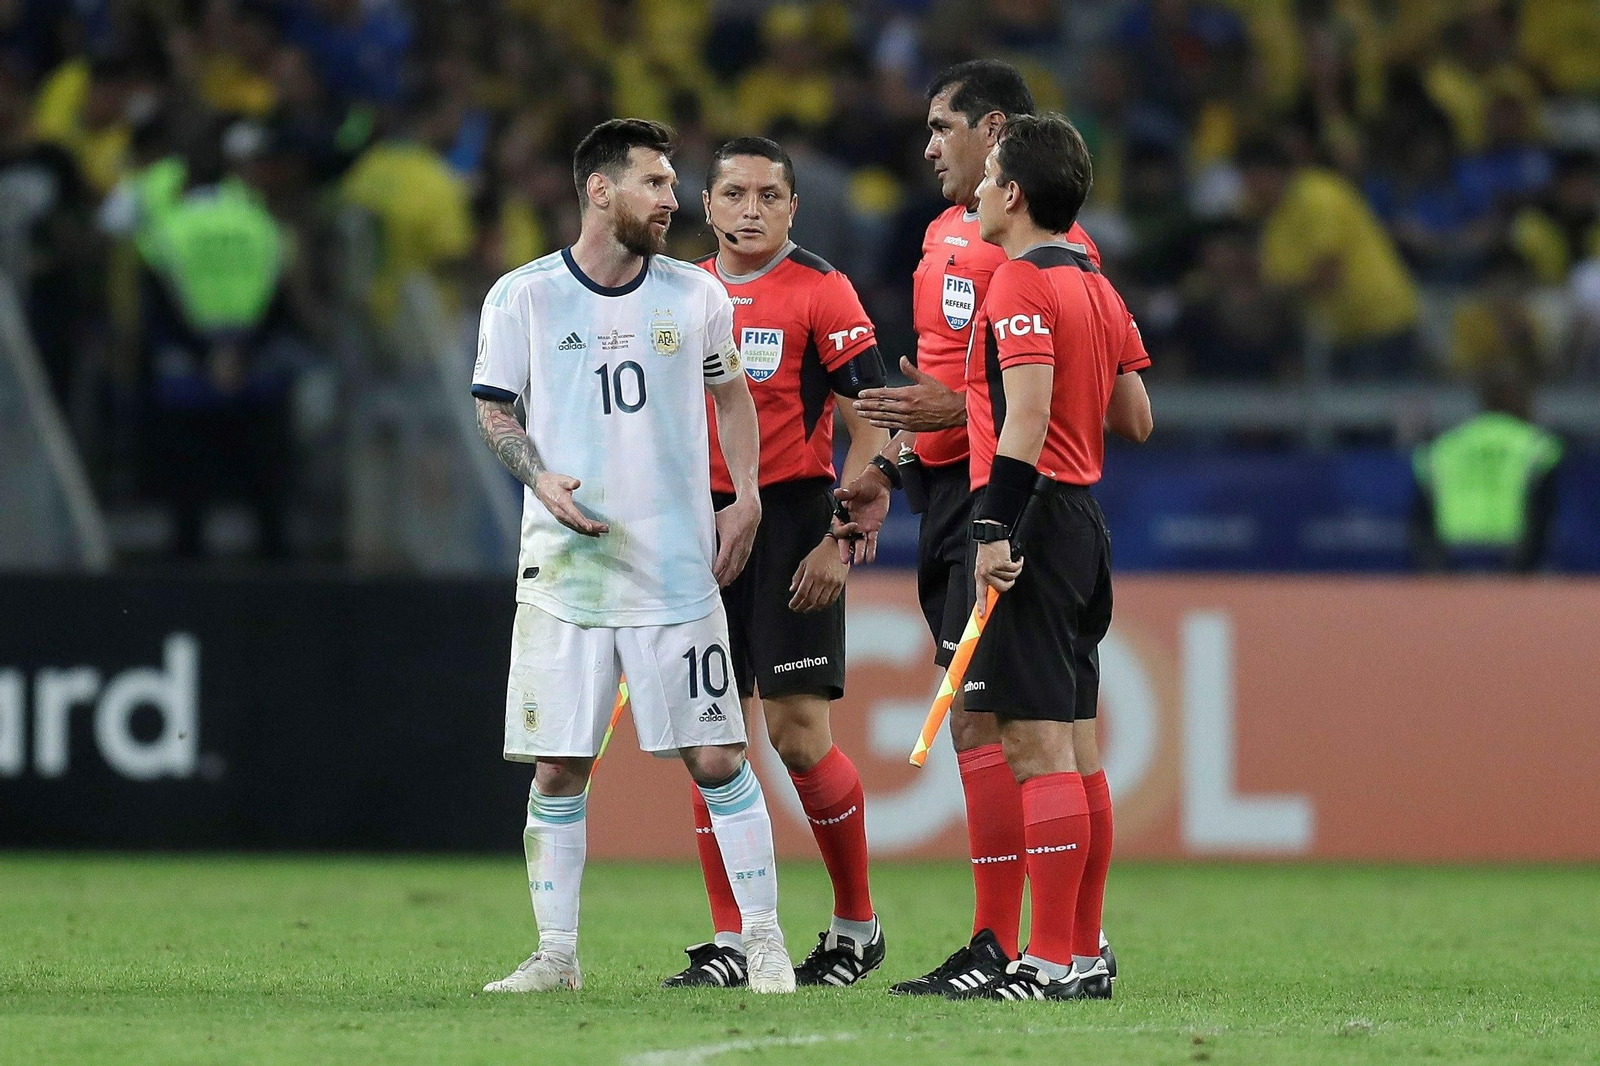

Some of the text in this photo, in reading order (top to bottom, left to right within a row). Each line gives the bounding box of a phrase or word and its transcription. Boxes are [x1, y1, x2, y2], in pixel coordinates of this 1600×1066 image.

[946, 278, 972, 294] FIFA
[945, 299, 971, 310] REFEREE
[995, 314, 1050, 340] TCL
[744, 331, 779, 345] FIFA
[828, 326, 874, 351] TC
[558, 342, 587, 351] adidas
[744, 350, 779, 358] ASSISTANT
[746, 356, 775, 364] REFEREE
[752, 369, 768, 378] 2019
[594, 360, 647, 415] 10
[773, 655, 829, 674] marathon
[682, 643, 729, 699] 10
[699, 713, 727, 722] adidas
[1026, 843, 1077, 854] athon
[971, 854, 1018, 864] athon
